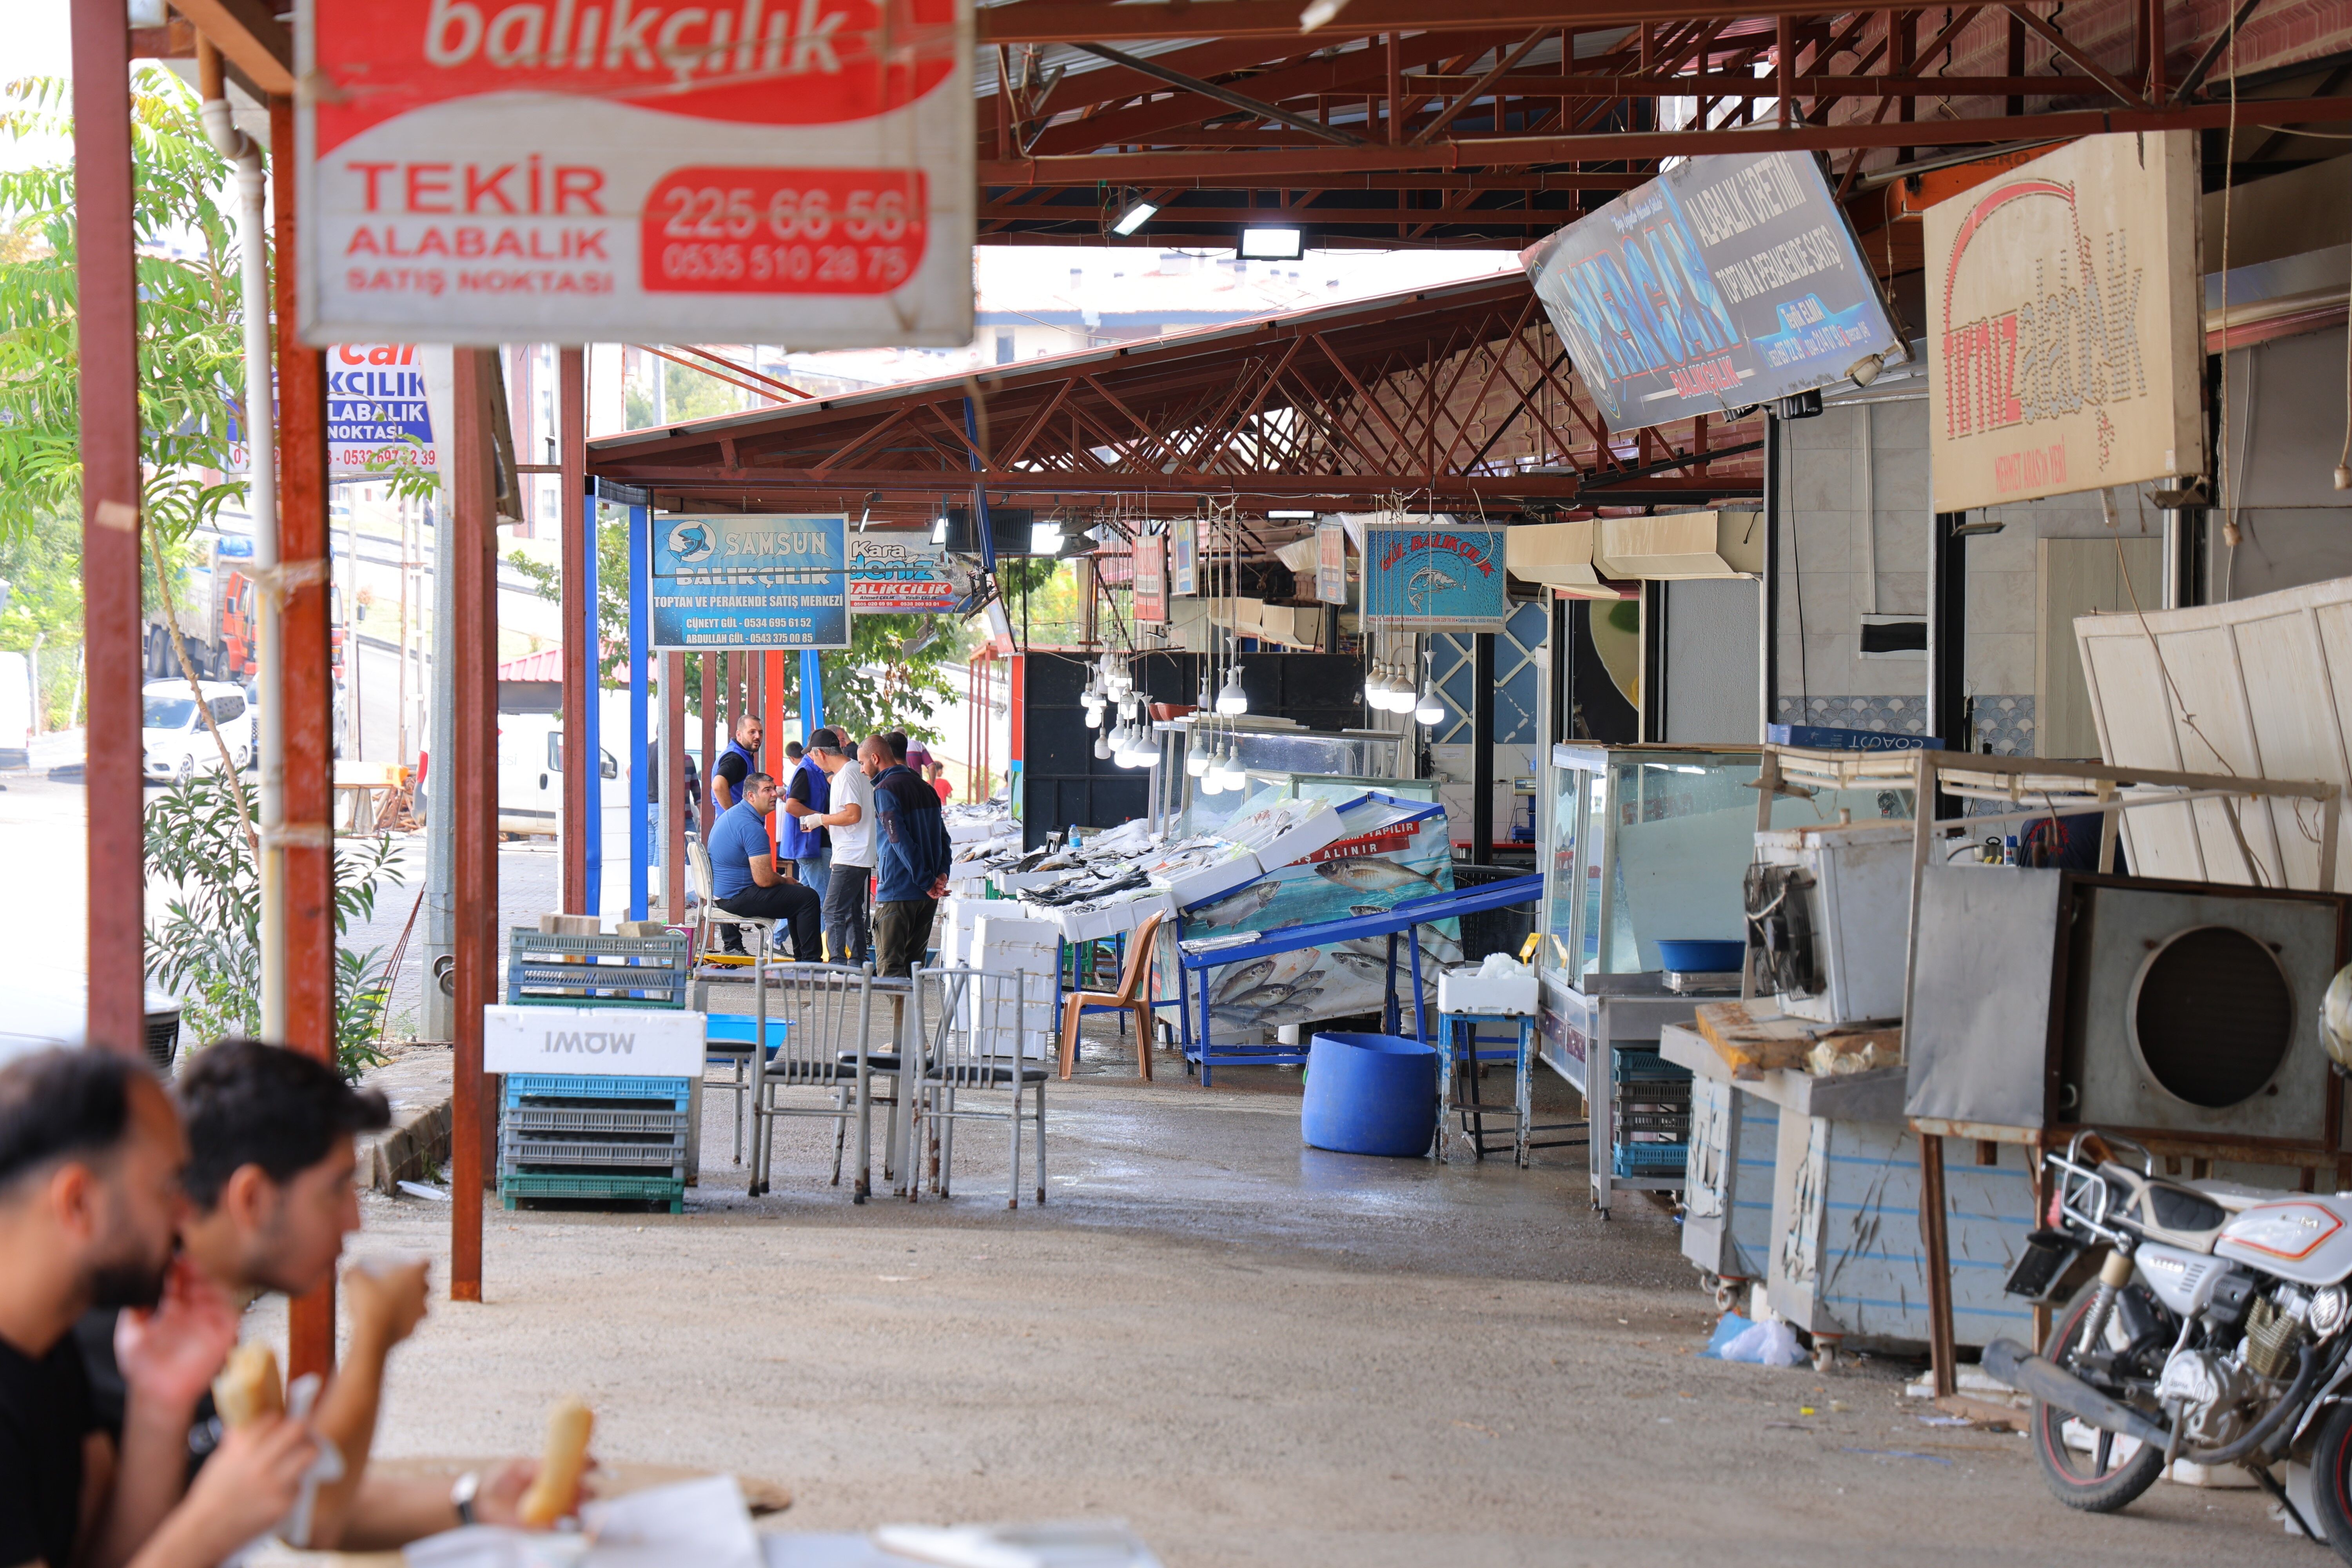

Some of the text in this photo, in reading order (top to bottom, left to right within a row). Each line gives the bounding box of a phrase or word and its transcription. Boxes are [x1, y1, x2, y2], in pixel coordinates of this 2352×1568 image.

[345, 153, 608, 215] TEKİR
[1686, 152, 1806, 247] ALABALIK ÜRETİMİ
[667, 189, 905, 239] 225 66 56
[345, 227, 608, 259] ALABALIK
[664, 247, 906, 280] 0535 510 28 75
[1715, 225, 1844, 304] TOPTAN & PERAKENDE SATIŞ
[347, 269, 614, 297] SATIŞ NOKTASI
[1557, 218, 1742, 384] MERCAN
[1780, 298, 1825, 333] Teyfik ELMA
[326, 372, 426, 397] KCILIK
[1669, 356, 1743, 399] BALIKÇILIK
[327, 403, 425, 421] LABALIK
[328, 425, 403, 439] NOKTASI
[421, 450, 435, 465] 39
[1995, 453, 2021, 493] MEHMET
[2048, 433, 2067, 484] YERİ
[721, 532, 832, 561] SAMSUN
[852, 541, 906, 557] Kara
[1380, 541, 1406, 571] GÜL
[1411, 533, 1495, 577] BALIKÇILIK
[675, 566, 833, 589] BALIKÇILIK
[654, 593, 843, 609] TOPTAN VE PERAKENDE SATIŞ MERKEZİ
[686, 617, 719, 628] CÜNEYT
[721, 617, 737, 628] GÜL
[744, 618, 767, 628] 0534
[769, 618, 787, 627] 695
[788, 618, 798, 627] 61
[800, 618, 811, 627] 52
[686, 634, 726, 643] ABDULLAH
[729, 632, 743, 643] GÜL
[750, 634, 771, 643] 0543
[773, 634, 788, 643] 375
[789, 634, 800, 642] 00
[802, 633, 813, 642] 85
[1849, 735, 1923, 749] COAST
[1369, 822, 1414, 838] YAPILIR
[1324, 844, 1377, 859] ALINIR
[545, 1031, 635, 1054] MOWI
